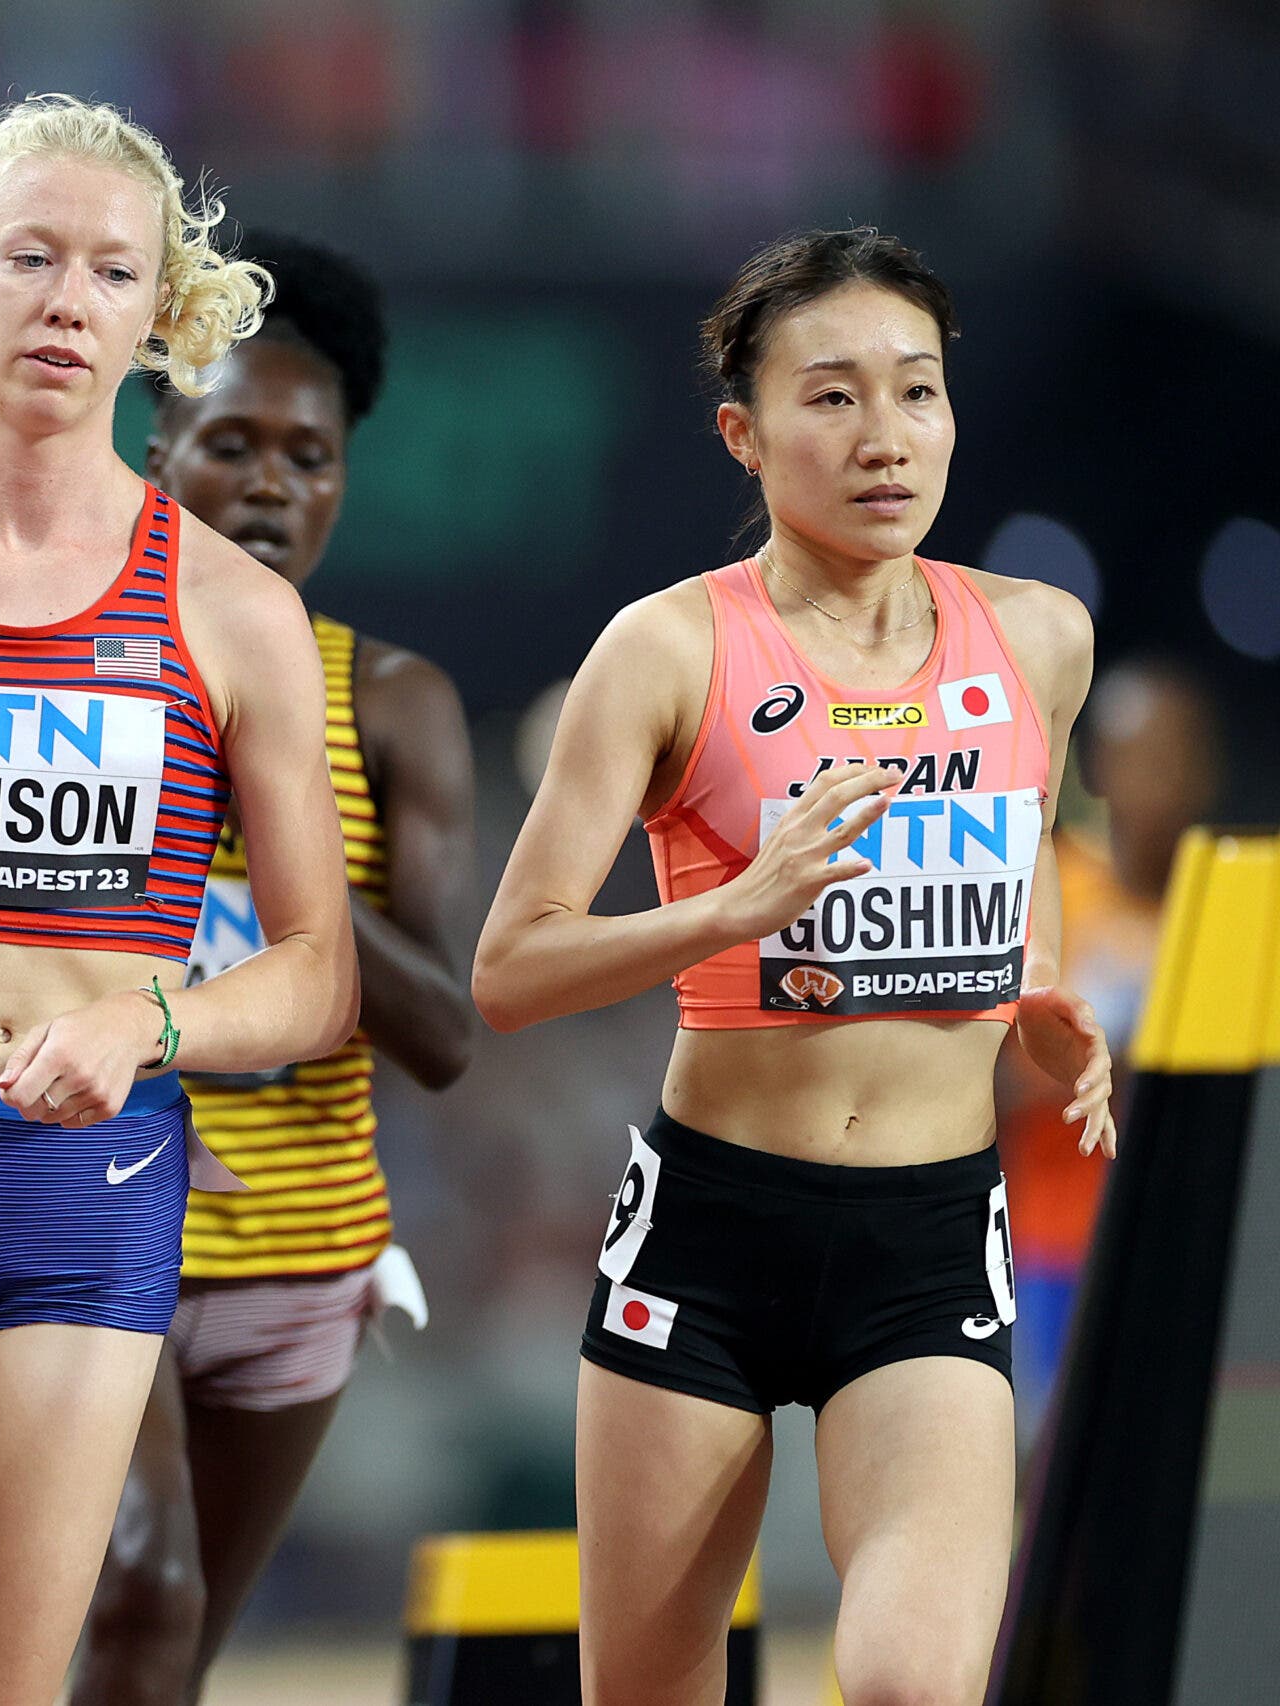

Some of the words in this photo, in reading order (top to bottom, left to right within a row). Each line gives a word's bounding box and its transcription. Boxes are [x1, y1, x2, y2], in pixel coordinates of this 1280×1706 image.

[832, 706, 922, 726] SEIKO
[96, 867, 130, 890] 23
[852, 970, 1004, 997] BUDAPEST
